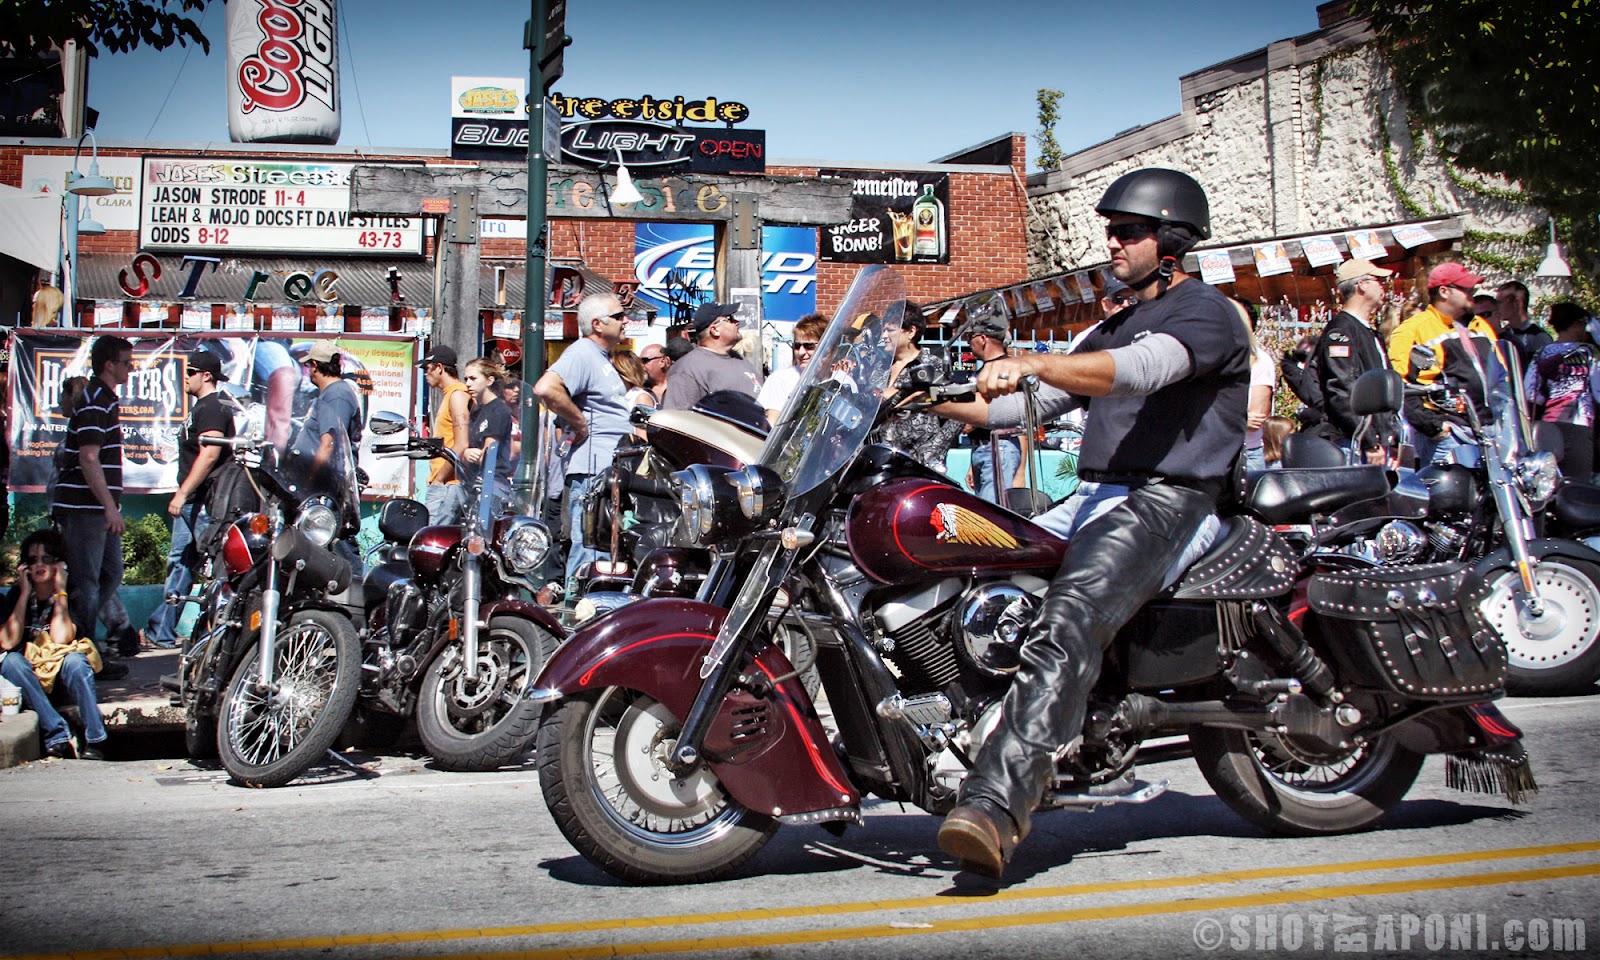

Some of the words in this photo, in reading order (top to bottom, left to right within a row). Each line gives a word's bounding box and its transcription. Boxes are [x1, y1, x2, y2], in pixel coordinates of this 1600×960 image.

[237, 0, 307, 114] Coo
[526, 94, 742, 122] treetside
[571, 129, 697, 153] LIGHT
[700, 139, 762, 159] OPEN
[96, 197, 133, 207] CLARA
[152, 186, 202, 204] JASON
[211, 188, 267, 206] STRODE
[151, 206, 187, 223] LEAH
[192, 207, 202, 223] &
[209, 208, 250, 225] MOJO
[255, 209, 293, 226] DOCS
[296, 210, 313, 227] FT
[316, 211, 355, 228] DAVE
[359, 217, 411, 229] STYLES
[481, 220, 507, 233] tra
[151, 226, 190, 244] ODDS
[198, 227, 230, 245] 8-12
[358, 231, 402, 249] 43-73
[832, 232, 883, 254] BOMB!
[22, 422, 37, 431] AN
[40, 423, 68, 433] ALTER
